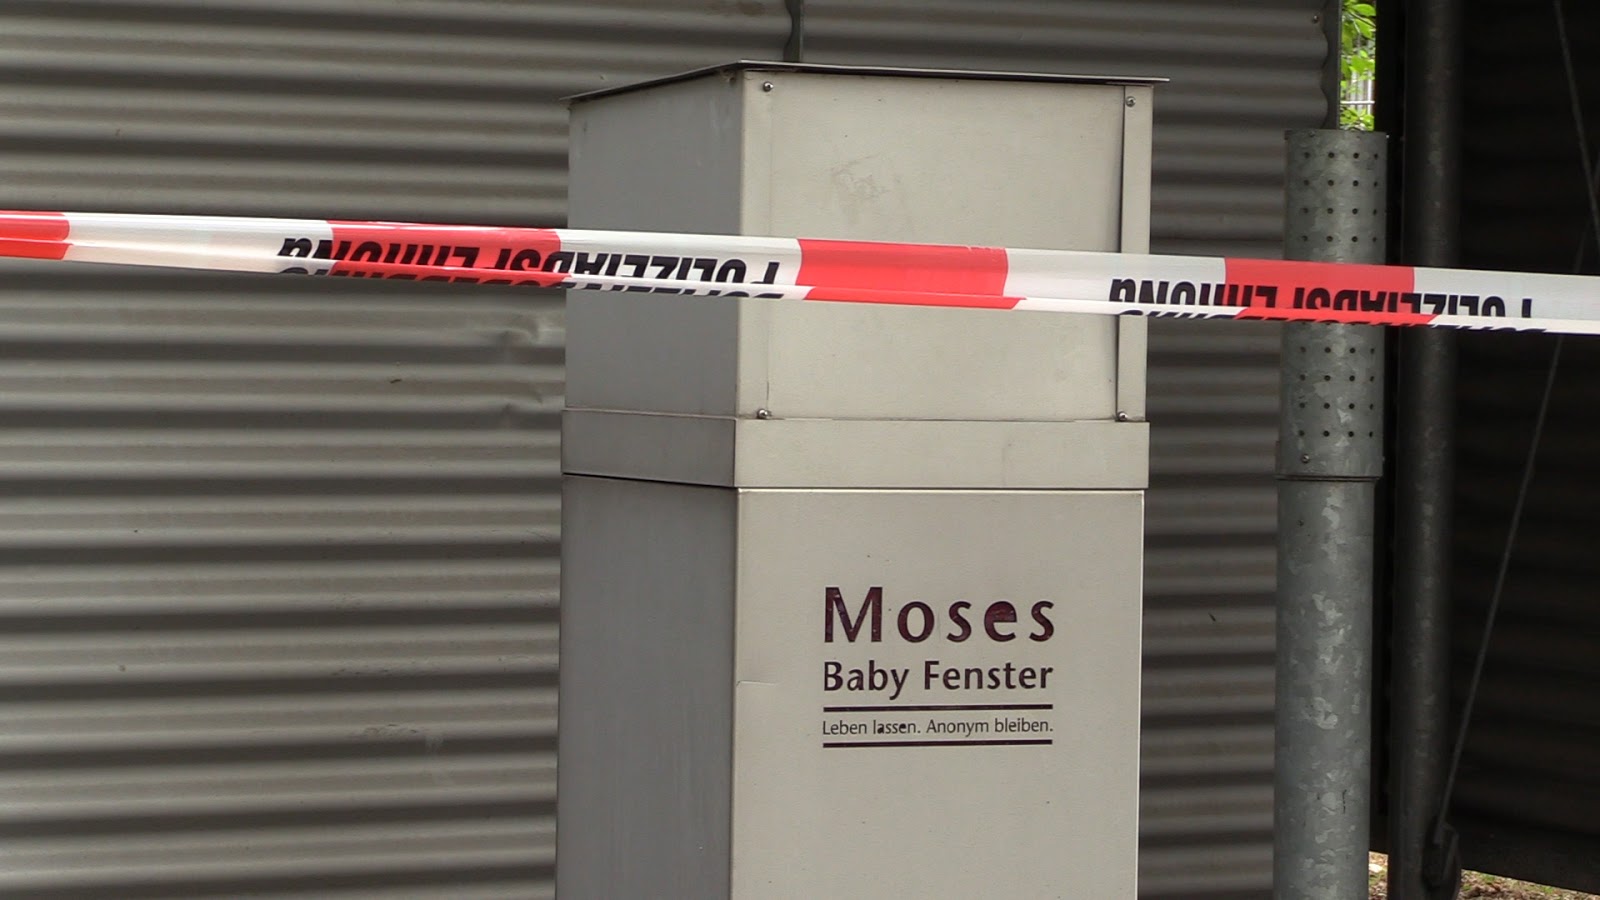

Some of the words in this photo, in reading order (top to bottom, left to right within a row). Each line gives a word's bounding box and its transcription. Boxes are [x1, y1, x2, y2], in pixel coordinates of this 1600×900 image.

[824, 586, 1055, 644] Moses
[823, 659, 910, 702] Baby
[924, 660, 1054, 692] Fenster
[822, 720, 868, 736] Leben
[872, 719, 921, 735] lassen.
[926, 719, 989, 738] Anonym
[994, 717, 1054, 733] bleiben.
